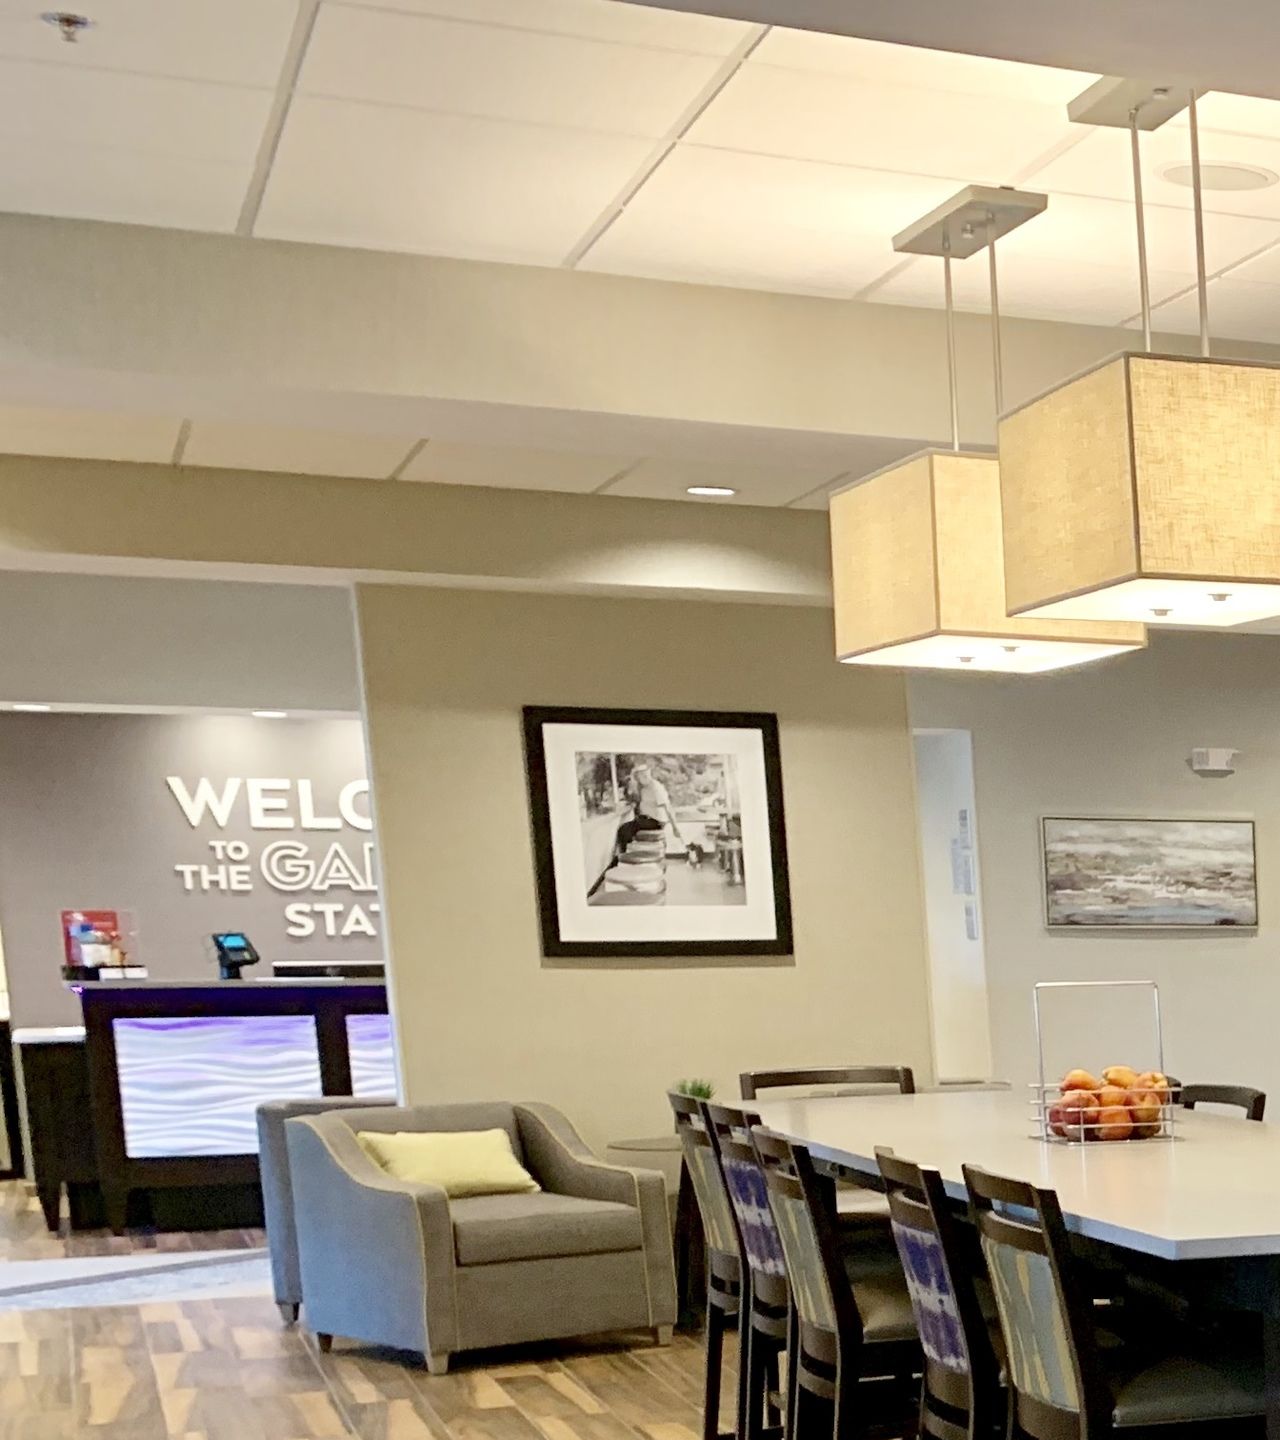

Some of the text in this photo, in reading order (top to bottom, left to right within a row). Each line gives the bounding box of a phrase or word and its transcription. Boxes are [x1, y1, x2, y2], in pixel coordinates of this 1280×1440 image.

[166, 776, 373, 830] WELC
[208, 840, 249, 861] TO
[174, 864, 253, 890] THE
